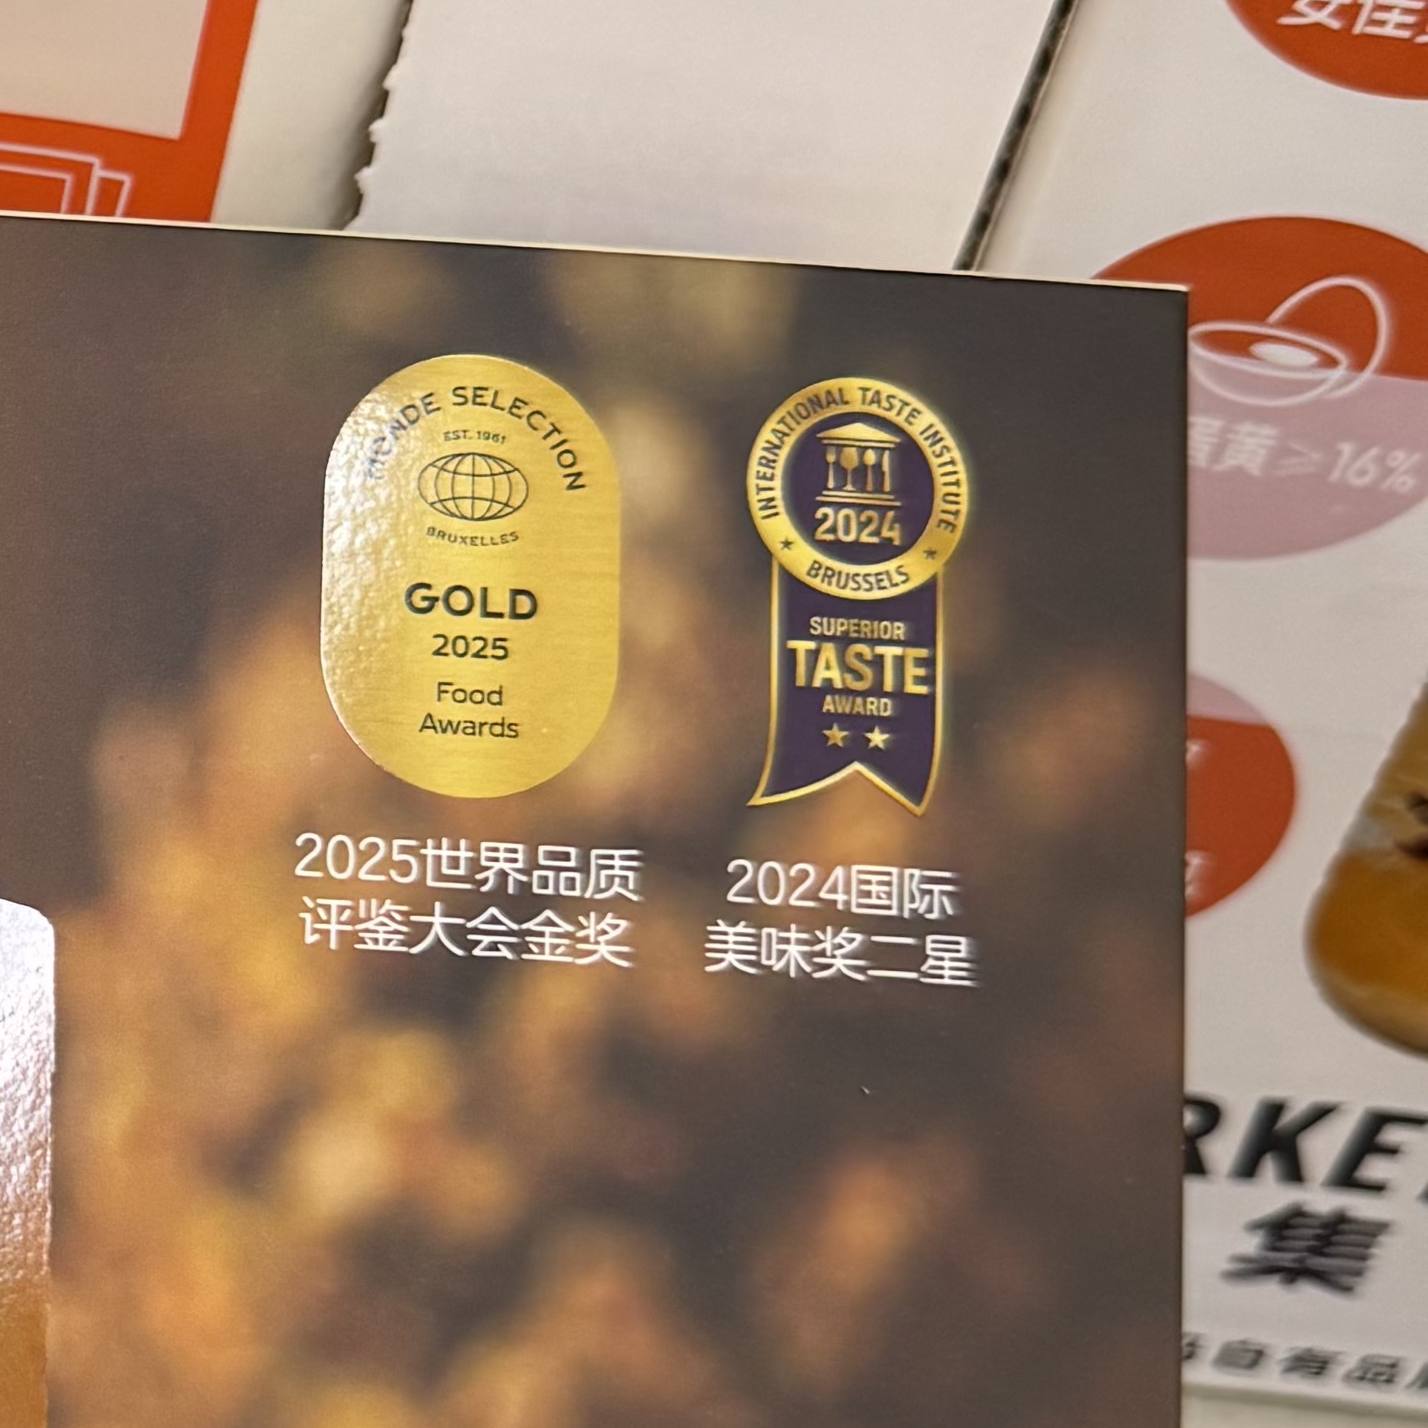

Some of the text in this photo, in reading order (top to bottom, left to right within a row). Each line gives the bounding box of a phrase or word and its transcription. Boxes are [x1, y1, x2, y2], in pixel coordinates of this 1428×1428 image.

[442, 429, 507, 446] EST. 1961
[451, 385, 588, 493] SELECTION
[755, 386, 962, 535] INTERNATIONAL TASTE INSTITUTE
[425, 526, 521, 548] BRUXELLES
[814, 506, 902, 547] 2024
[805, 559, 911, 593] BRUSSELS
[404, 581, 540, 622] GOLD
[431, 633, 511, 661] 2025
[808, 615, 907, 641] SUPERIOR
[785, 639, 931, 695] TASTE
[436, 681, 504, 707] Food
[821, 694, 893, 717] AWARD
[418, 712, 520, 739] Awards
[293, 831, 642, 902] 2025世界品质
[725, 858, 960, 921] 2024国际
[297, 895, 640, 969] 评鉴大会金奖
[704, 918, 977, 988] 美味奖二星
